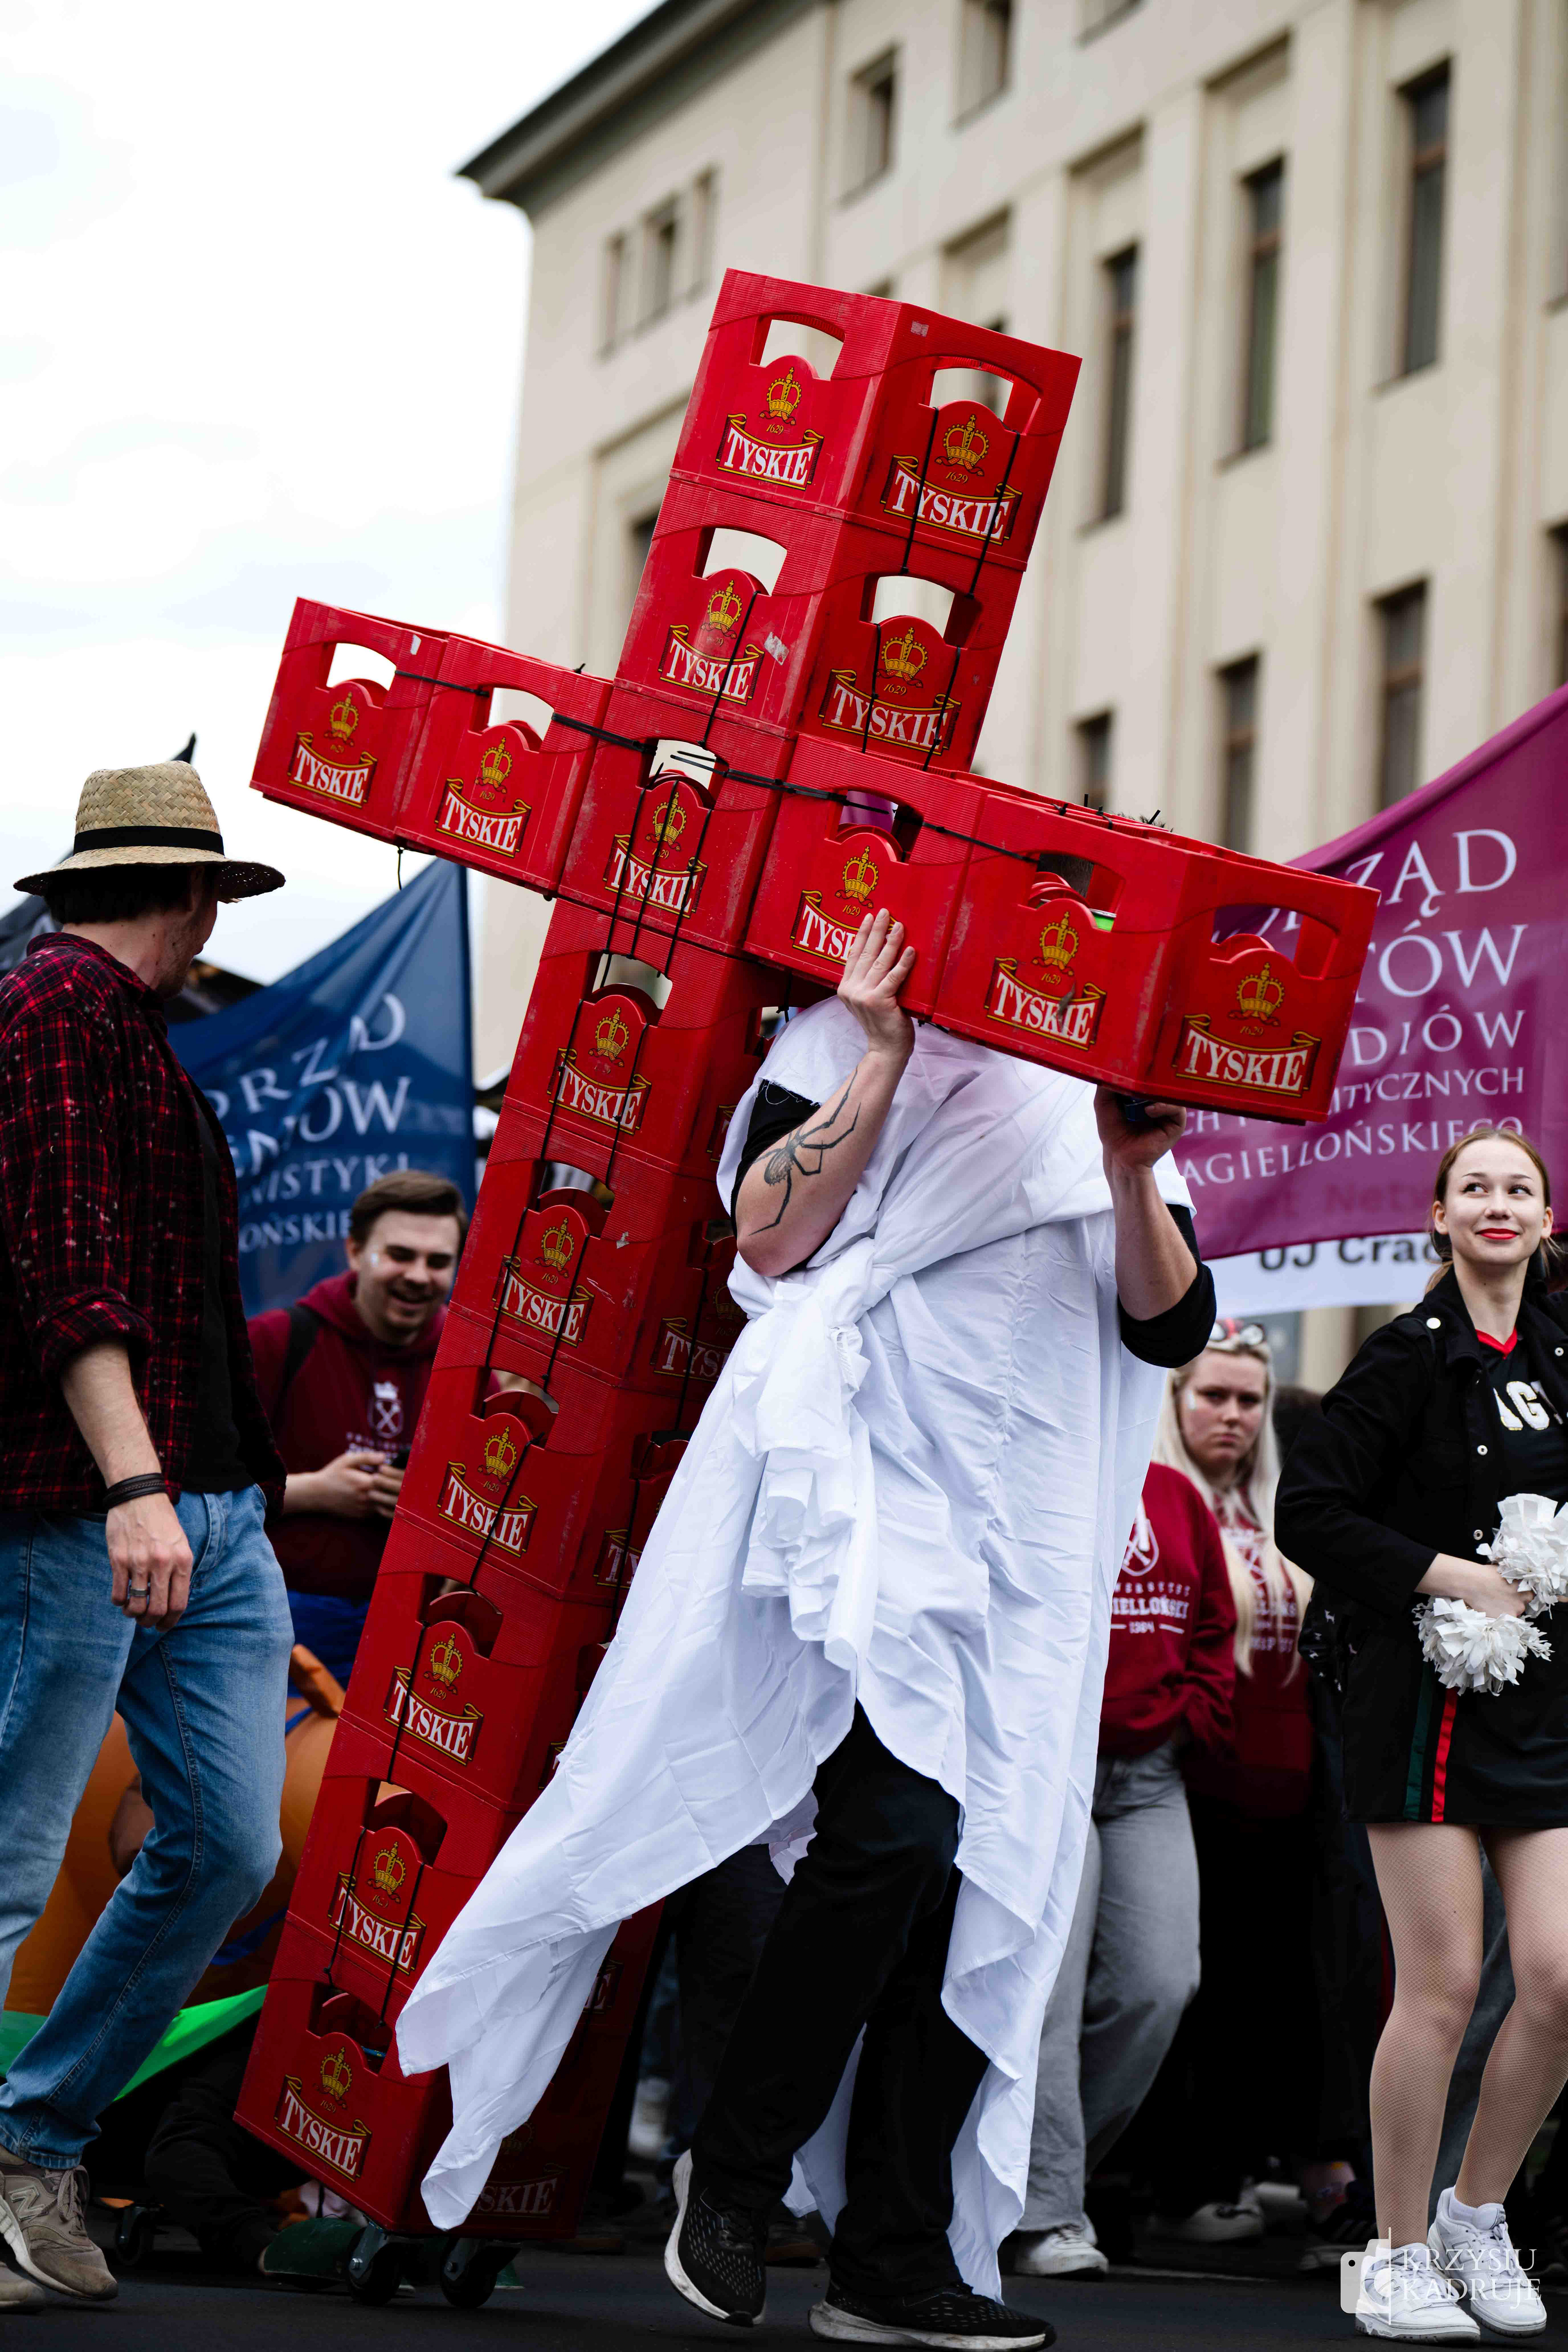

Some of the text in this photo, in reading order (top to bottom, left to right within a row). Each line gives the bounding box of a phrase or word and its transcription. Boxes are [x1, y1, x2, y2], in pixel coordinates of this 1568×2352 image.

[724, 428, 813, 484] TYSKIE
[766, 424, 784, 435] 1629
[893, 470, 1009, 538] TYSKIE
[946, 472, 968, 484] 1629
[667, 639, 754, 699] TYSKIE
[884, 684, 906, 695] 1629
[832, 684, 947, 749] TYSKIE
[294, 746, 368, 802] TYSKIE
[479, 791, 495, 802] 1629
[442, 792, 522, 851] TYSKIE
[611, 848, 697, 911] TYSKIE
[652, 849, 669, 859] 129
[842, 905, 860, 917] 1629
[1041, 973, 1060, 984] 1629
[994, 973, 1094, 1042] TYSKIE
[1189, 1030, 1306, 1089] TYSKIE
[557, 1065, 641, 1128] TYSKIE
[1328, 1066, 1524, 1115] ITYCZNYCH
[503, 1275, 584, 1340] TYSKIE
[541, 1274, 558, 1285] 1629
[445, 1476, 527, 1550] TYSKIE
[483, 1481, 499, 1492] 1629
[391, 1680, 472, 1758] TYSKIE
[430, 1688, 447, 1699] 1629
[336, 1887, 416, 1968] TYSKIE
[282, 2090, 361, 2174] TYSKIE
